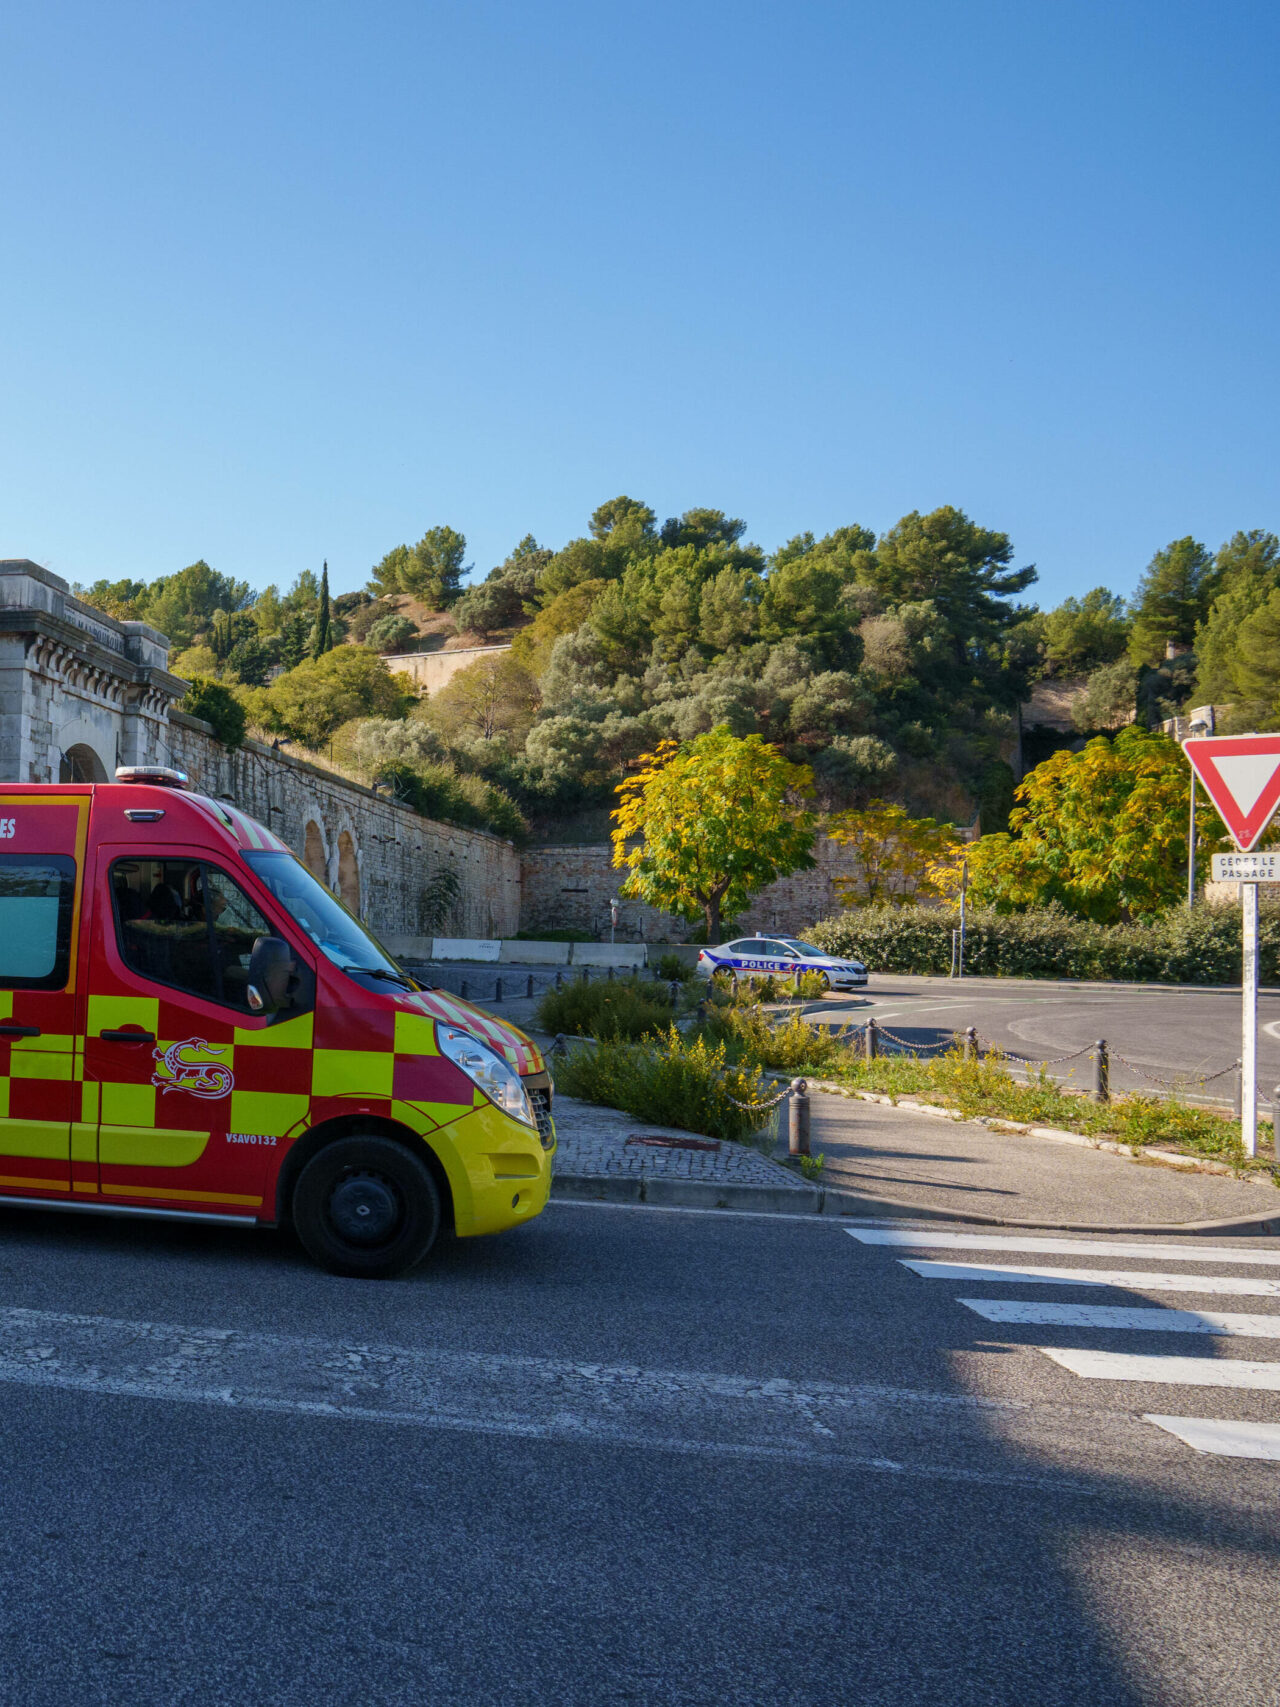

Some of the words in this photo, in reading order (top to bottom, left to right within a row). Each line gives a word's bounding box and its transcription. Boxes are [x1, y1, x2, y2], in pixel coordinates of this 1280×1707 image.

[1262, 857, 1275, 866] LE
[1222, 869, 1274, 878] PASSAGE
[741, 960, 780, 970] POLICE
[226, 1133, 277, 1146] VSAV0132
